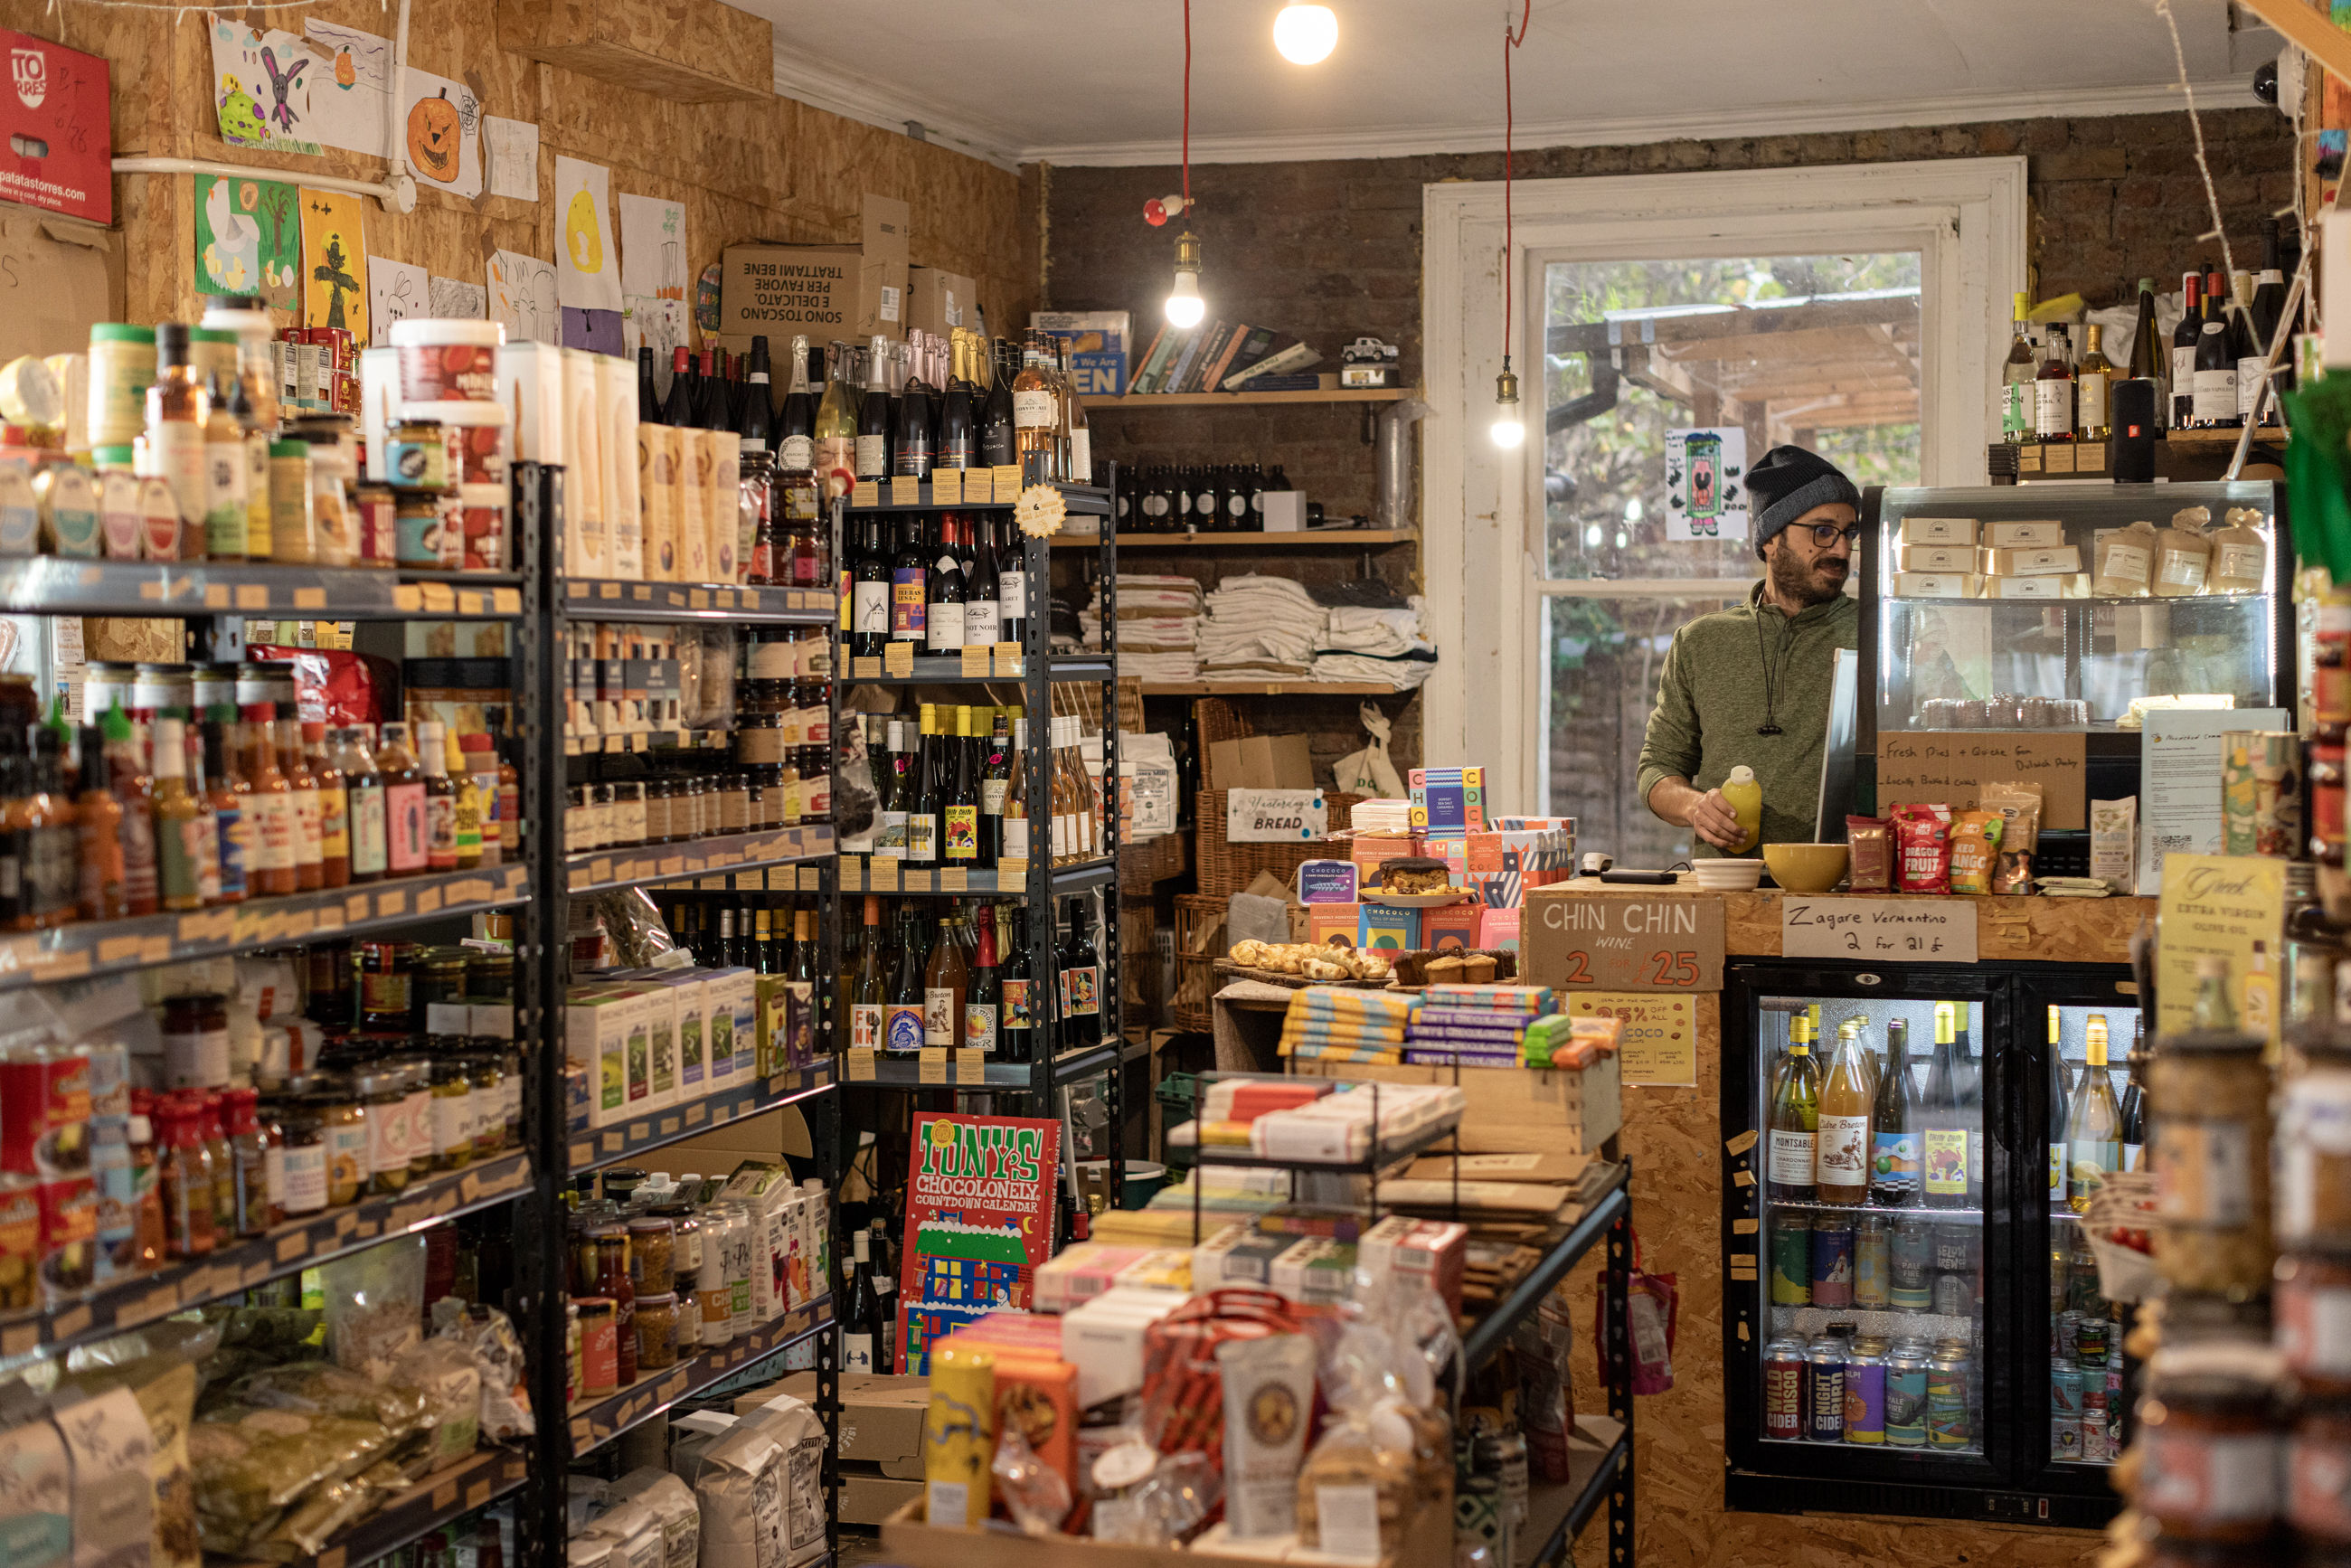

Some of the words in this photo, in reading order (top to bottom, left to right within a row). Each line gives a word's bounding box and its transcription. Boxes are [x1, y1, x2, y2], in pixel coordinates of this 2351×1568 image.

[0, 171, 86, 202] patatastorres.com
[24, 191, 37, 201] cool,
[38, 194, 47, 204] dry
[47, 195, 62, 206] place.
[743, 263, 777, 276] BENE
[779, 264, 844, 279] TRATTAMI
[754, 279, 804, 293] FAVORE
[807, 281, 831, 293] PER
[754, 293, 820, 307] DELICATO.
[823, 297, 830, 307] E
[741, 307, 804, 322] TOSCANO
[805, 310, 843, 324] SONO
[1081, 358, 1097, 366] We
[1100, 358, 1118, 366] Are
[1076, 368, 1118, 393] EN
[1034, 503, 1040, 511] 6
[1886, 741, 1917, 759] Fresh
[1925, 746, 1950, 759] Pies
[1921, 775, 1950, 785] Baked
[1248, 795, 1310, 815] Yesterday's
[1254, 817, 1302, 830] BREAD
[1904, 846, 1940, 857] DRAGON
[1904, 857, 1940, 872] FRUIT
[1951, 855, 1987, 869] ANGO
[2176, 902, 2217, 916] EXTRA
[1543, 902, 1605, 930] CHIN
[1623, 903, 1696, 934] CHIN
[1788, 905, 1863, 930] Zagare
[1595, 936, 1636, 949] WINE
[1844, 930, 1862, 951] 2
[1906, 936, 1923, 951] 21
[1931, 937, 1943, 952] £
[1565, 949, 1594, 984] 2
[1610, 959, 1631, 968] FOR
[1632, 949, 1701, 987] £25
[929, 991, 951, 999] Breton
[1625, 1027, 1664, 1038] COCO
[1818, 1119, 1836, 1129] Cidre
[1839, 1119, 1866, 1129] Breton
[919, 1120, 1044, 1183] TONY'S
[1052, 1124, 1062, 1189] CALENDAR
[1775, 1156, 1812, 1164] CHARDONNAY
[916, 1175, 1039, 1201] CHOCOLONELY
[915, 1195, 982, 1210] COUNTDOWN
[982, 1198, 1039, 1214] CALENDAR
[1047, 1190, 1058, 1262] COUNTDOWN
[1937, 1244, 1966, 1257] BELOW
[1902, 1261, 1921, 1270] PALE
[1937, 1257, 1958, 1270] BREW
[1903, 1270, 1921, 1278] FIRE
[1767, 1369, 1783, 1412] WILD
[1782, 1370, 1798, 1413] DISCO
[1815, 1372, 1830, 1415] NIGHT
[1886, 1397, 1904, 1405] PALE
[1887, 1404, 1903, 1412] FIRE
[1767, 1412, 1798, 1429] CIDER
